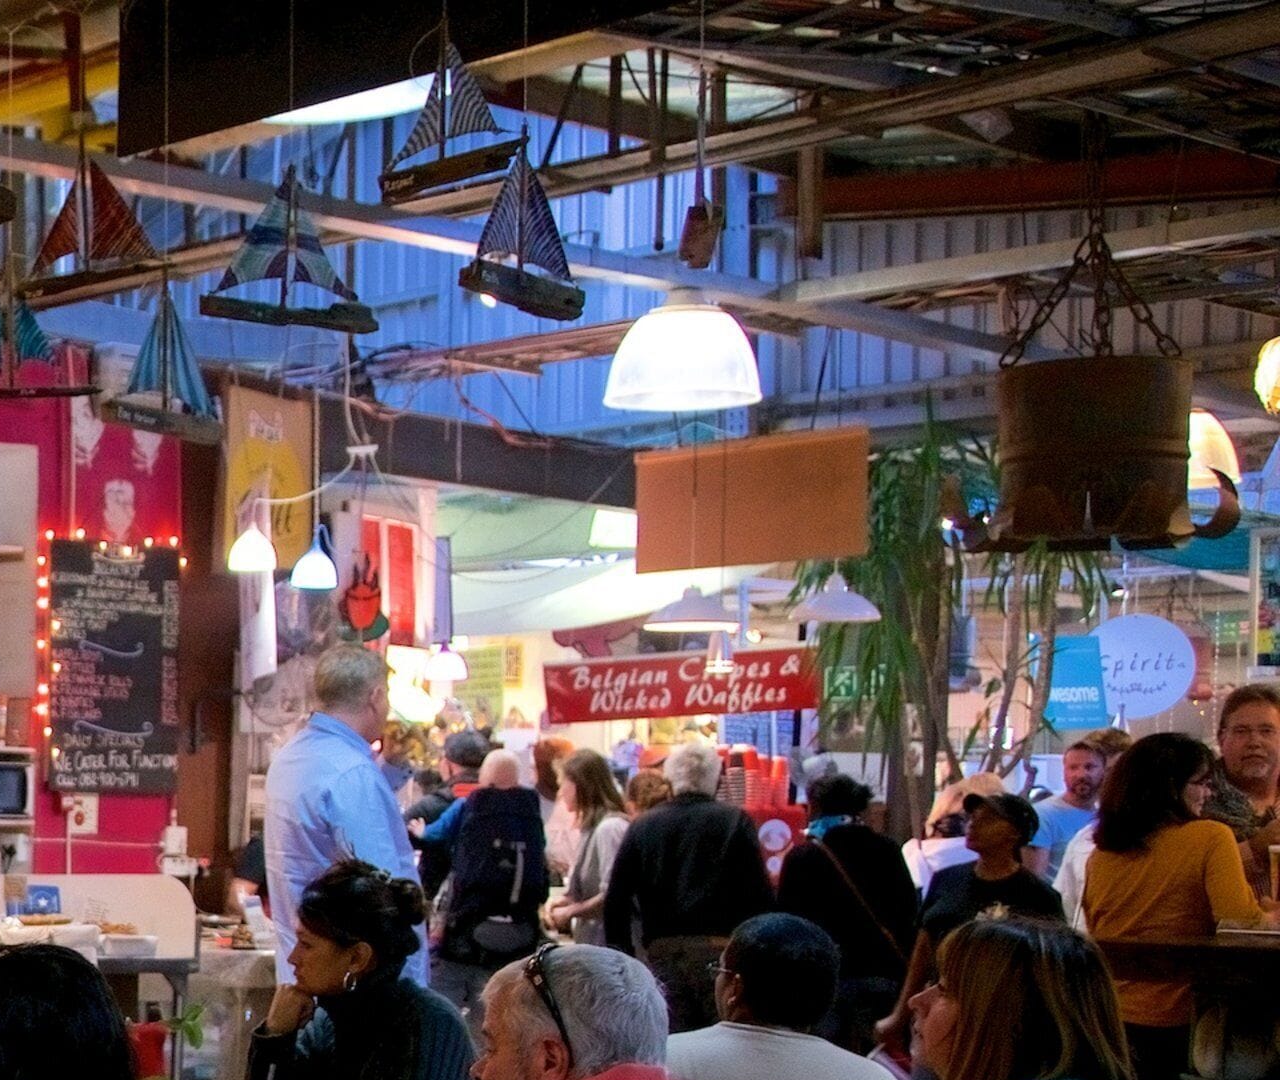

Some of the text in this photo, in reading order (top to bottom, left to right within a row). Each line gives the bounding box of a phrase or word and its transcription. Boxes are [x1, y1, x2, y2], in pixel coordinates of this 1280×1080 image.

[571, 665, 668, 694] Belgian
[779, 654, 801, 676] &
[590, 683, 788, 714] Wicked Waffles
[1049, 685, 1099, 703] wesome
[74, 749, 107, 770] CATER
[108, 749, 131, 769] FOR
